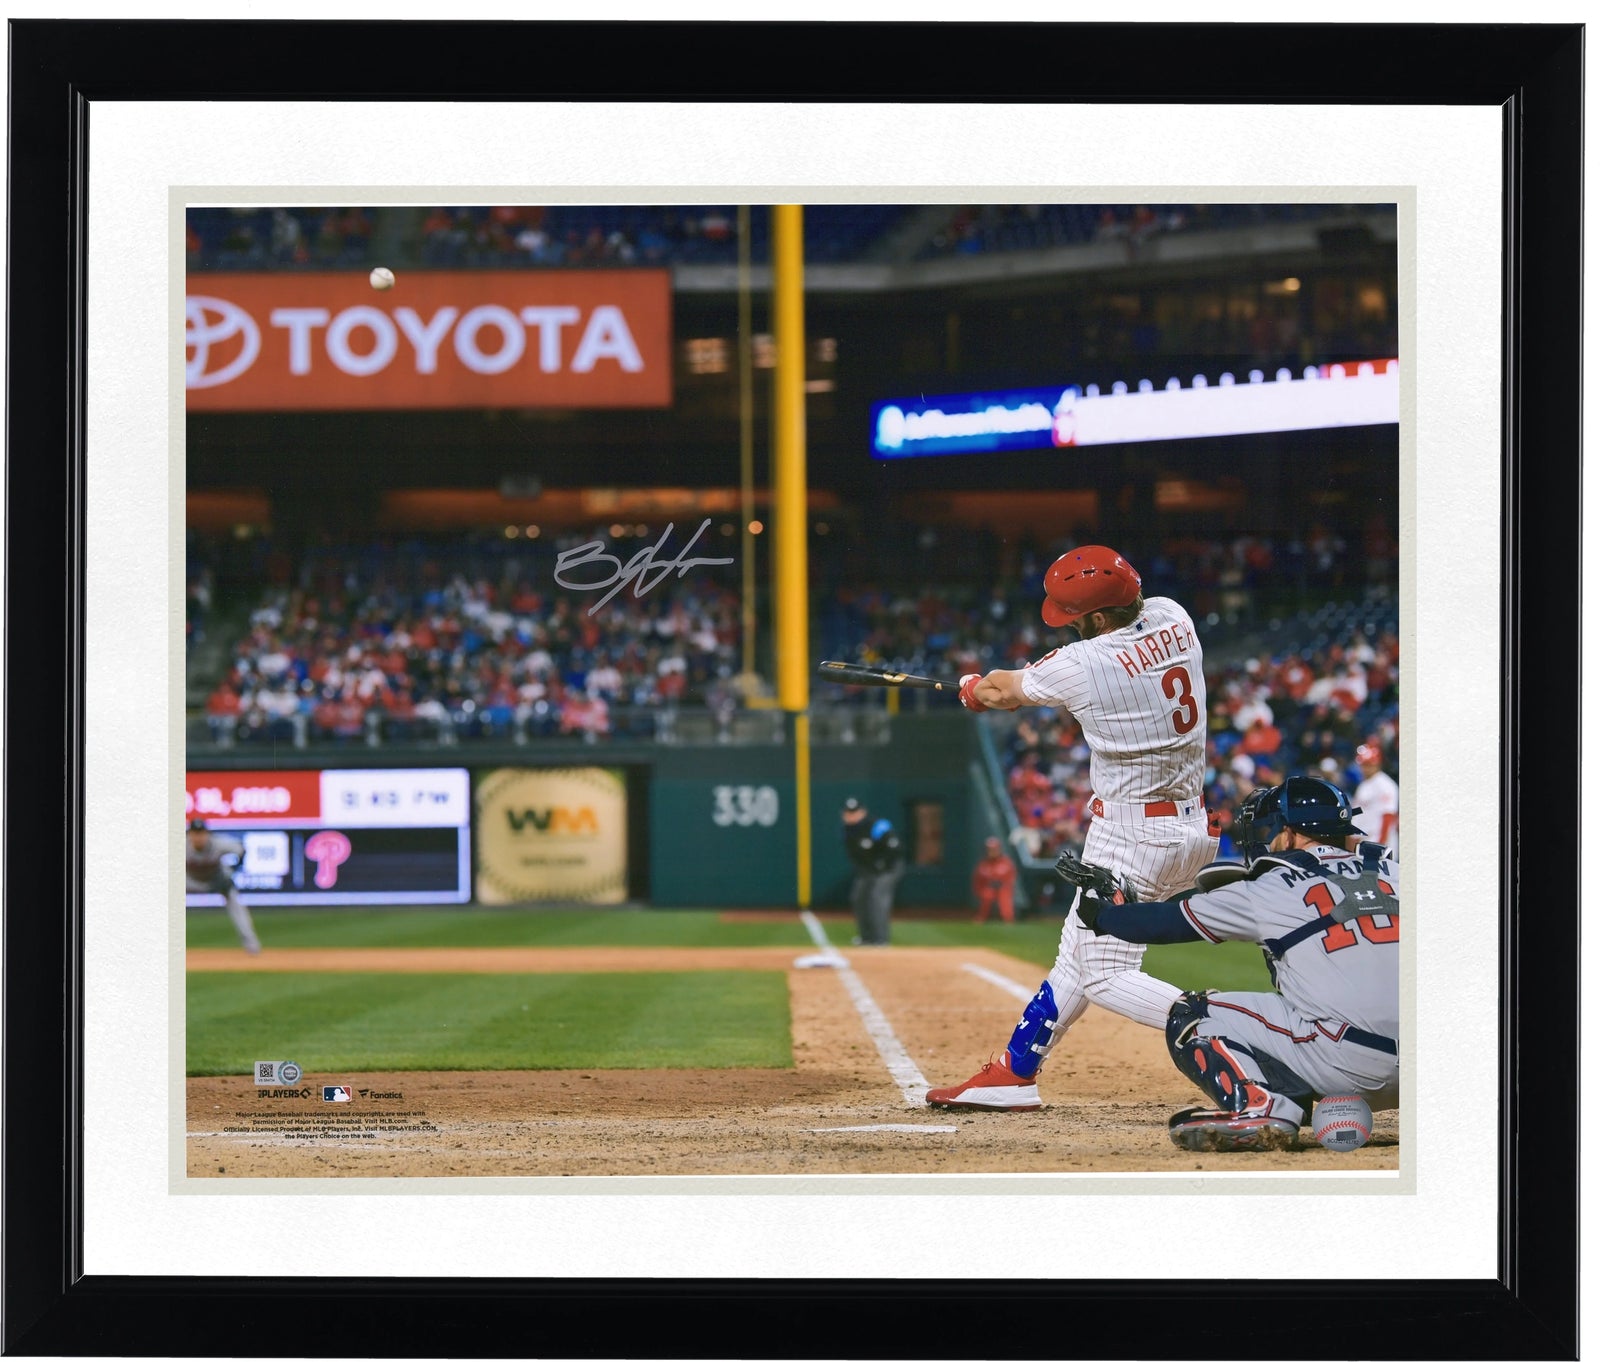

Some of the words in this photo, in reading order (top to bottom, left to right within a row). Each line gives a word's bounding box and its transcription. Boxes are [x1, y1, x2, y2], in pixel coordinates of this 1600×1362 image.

[270, 305, 644, 377] TOYOTA
[1116, 620, 1195, 679] HARPER
[1161, 666, 1199, 735] 3
[504, 807, 600, 836] WM
[711, 785, 779, 827] 330
